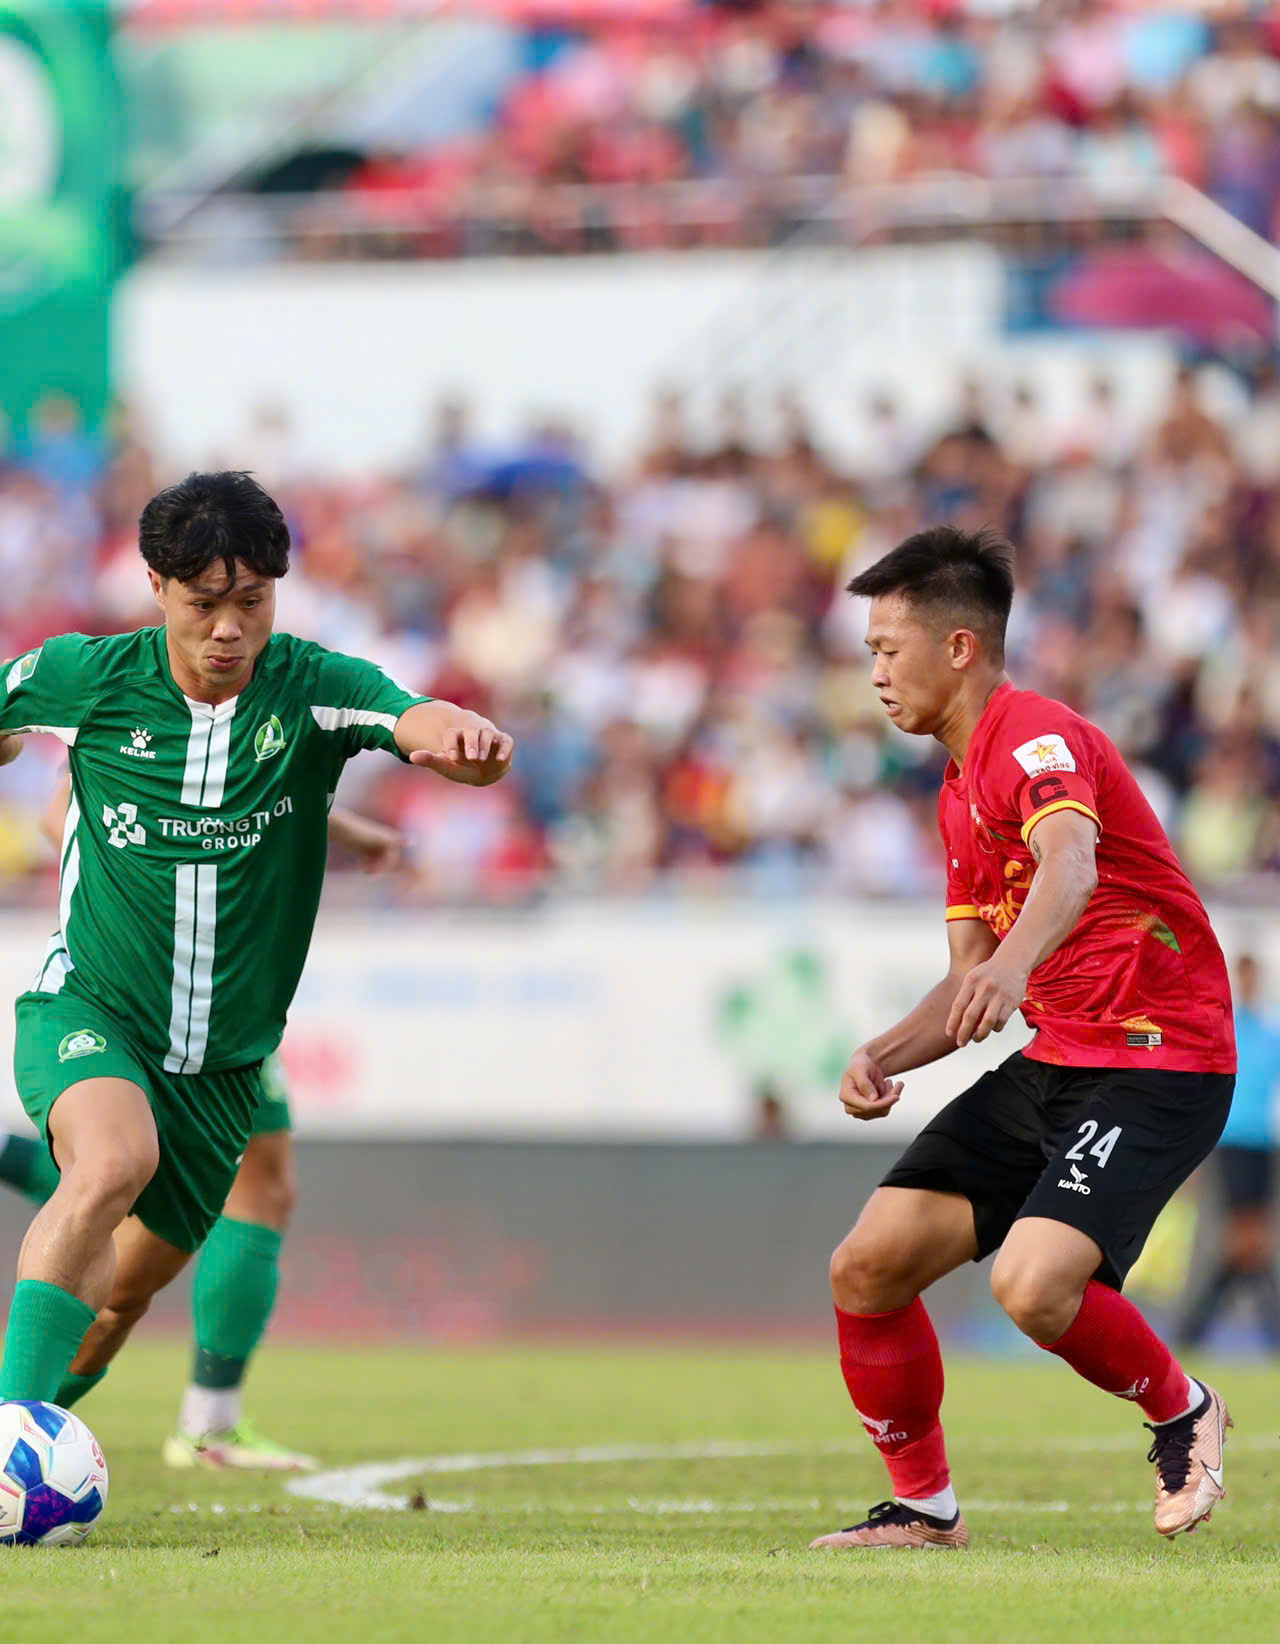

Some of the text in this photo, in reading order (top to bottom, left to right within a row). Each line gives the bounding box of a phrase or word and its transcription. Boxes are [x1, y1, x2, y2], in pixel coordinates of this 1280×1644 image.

[120, 745, 157, 759] KELME
[158, 816, 251, 837] TRƯỜNG
[202, 833, 262, 850] GROUP
[1064, 1119, 1123, 1169] 24
[1057, 1178, 1091, 1195] KAMITO
